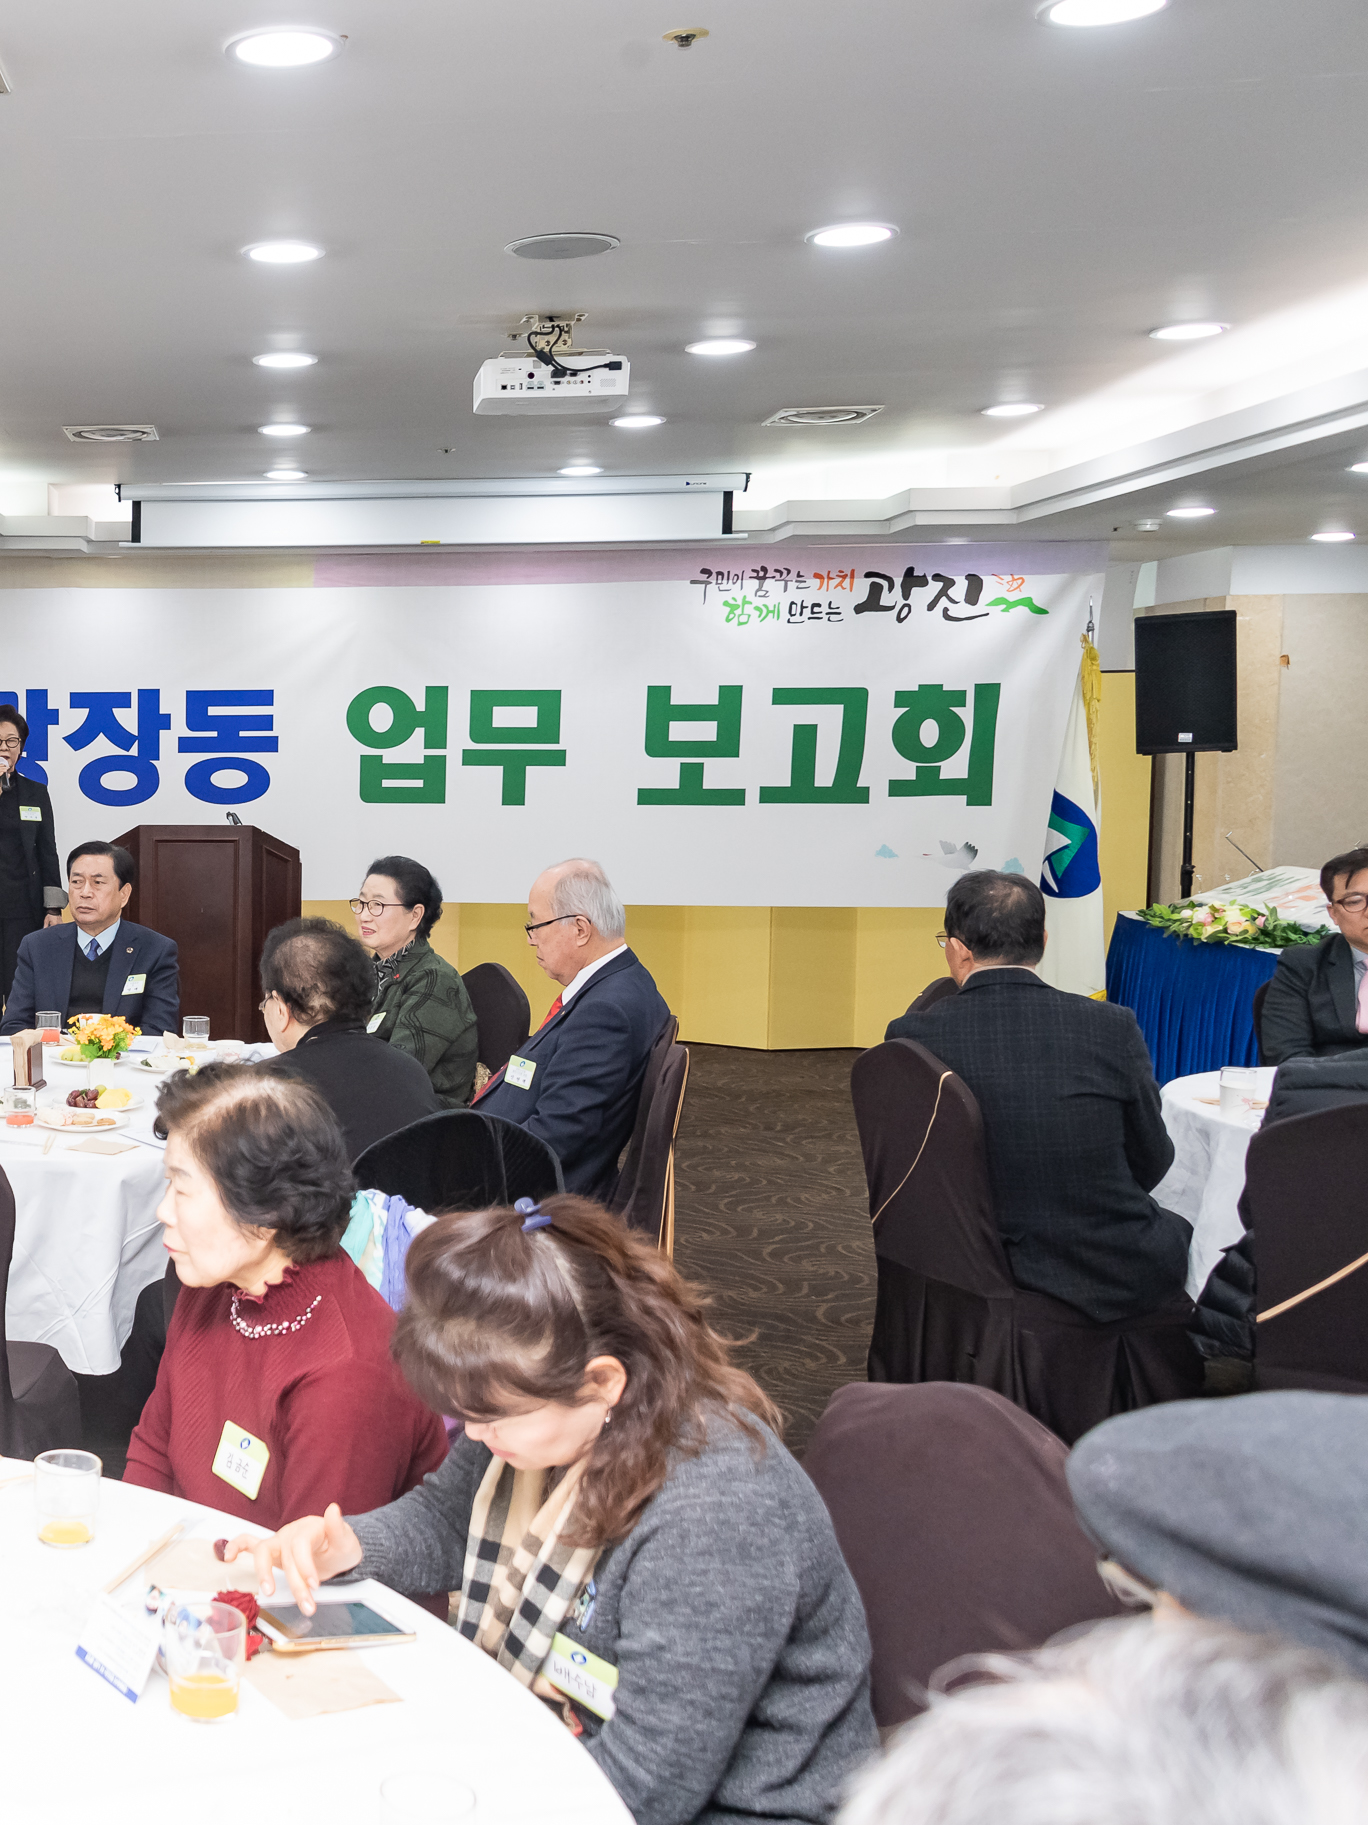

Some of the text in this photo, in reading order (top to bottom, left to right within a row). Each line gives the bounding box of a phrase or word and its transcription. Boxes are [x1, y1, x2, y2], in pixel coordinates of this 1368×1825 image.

[690, 565, 856, 604] 구민이 꿈꾸는 가치
[853, 565, 990, 624] 광진
[723, 595, 844, 626] 함께 만드는
[346, 685, 566, 805] 업무
[637, 683, 1001, 806] 보고회
